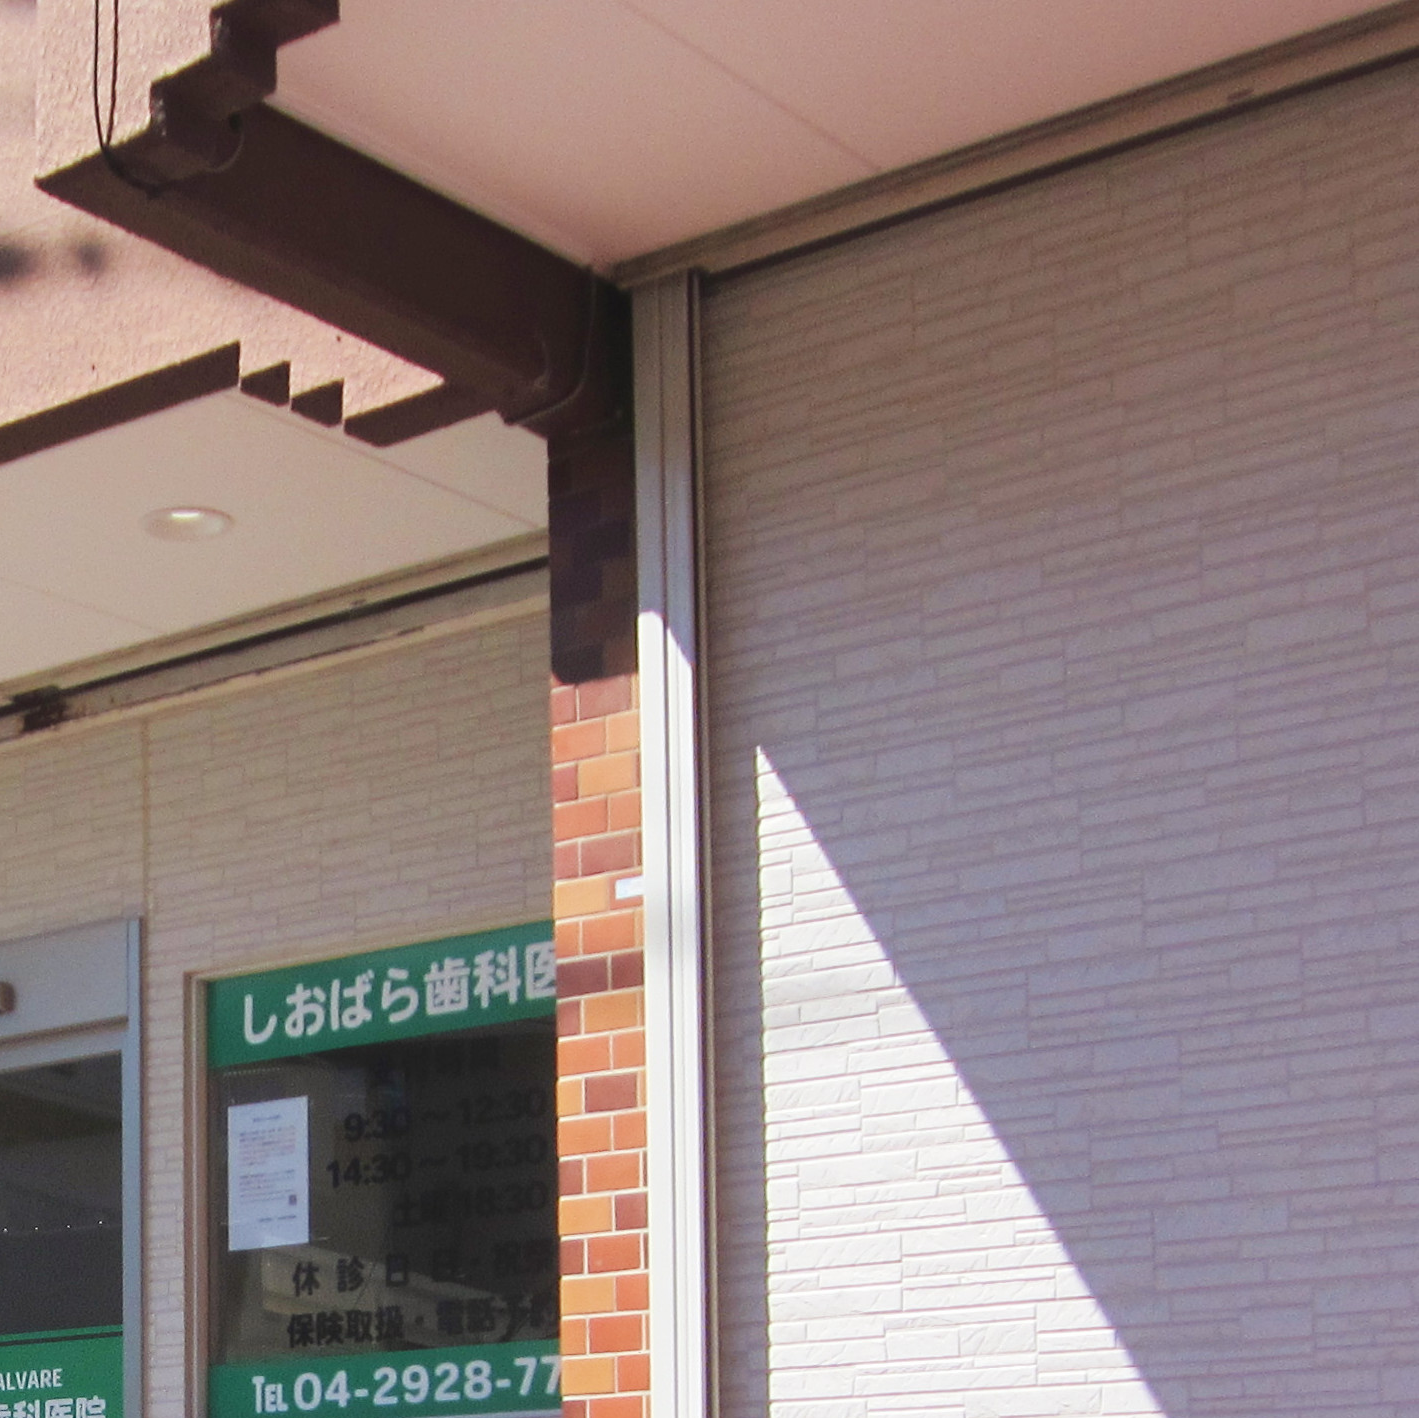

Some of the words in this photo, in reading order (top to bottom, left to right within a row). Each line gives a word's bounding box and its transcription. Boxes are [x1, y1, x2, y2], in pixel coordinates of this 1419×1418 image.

[243, 940, 556, 1044] しおばら歯科医
[293, 1355, 561, 1409] 04-2928-77
